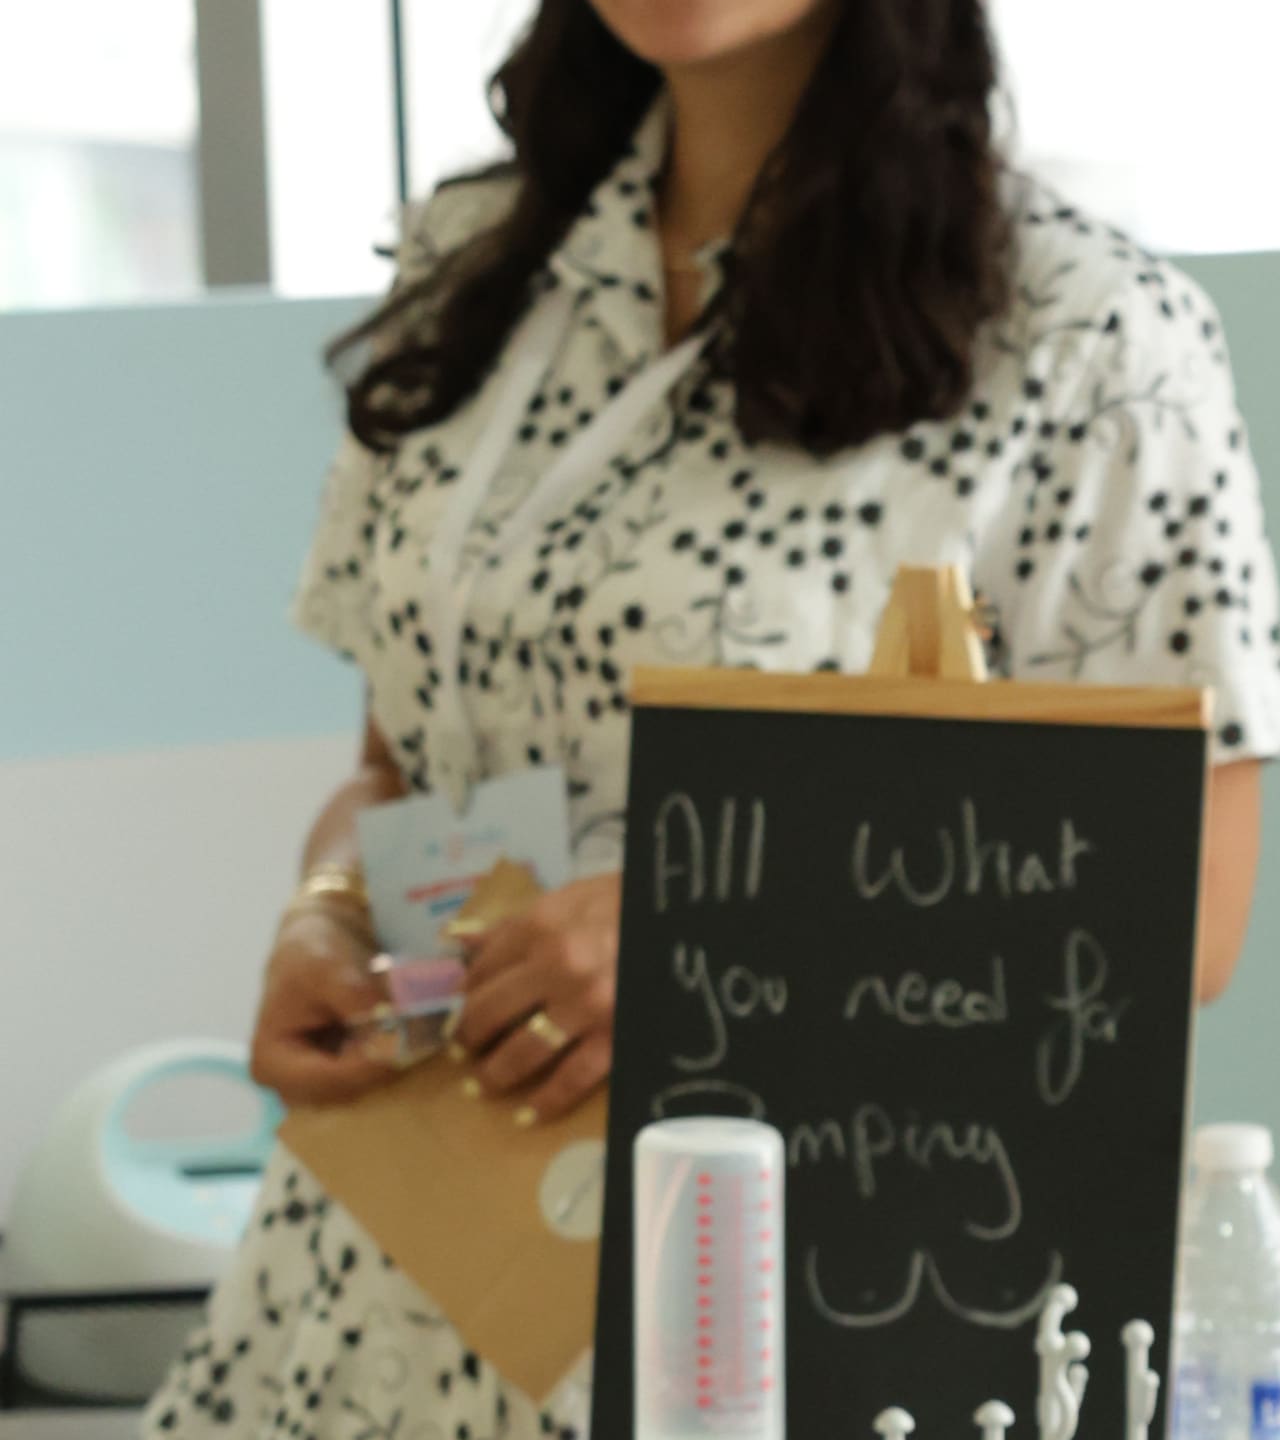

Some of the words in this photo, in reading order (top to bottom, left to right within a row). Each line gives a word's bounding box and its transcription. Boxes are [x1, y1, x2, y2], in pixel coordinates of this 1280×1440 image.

[654, 791, 766, 913] All
[672, 941, 789, 1072] you
[844, 956, 1010, 1028] need
[652, 1078, 1023, 1241] mping
